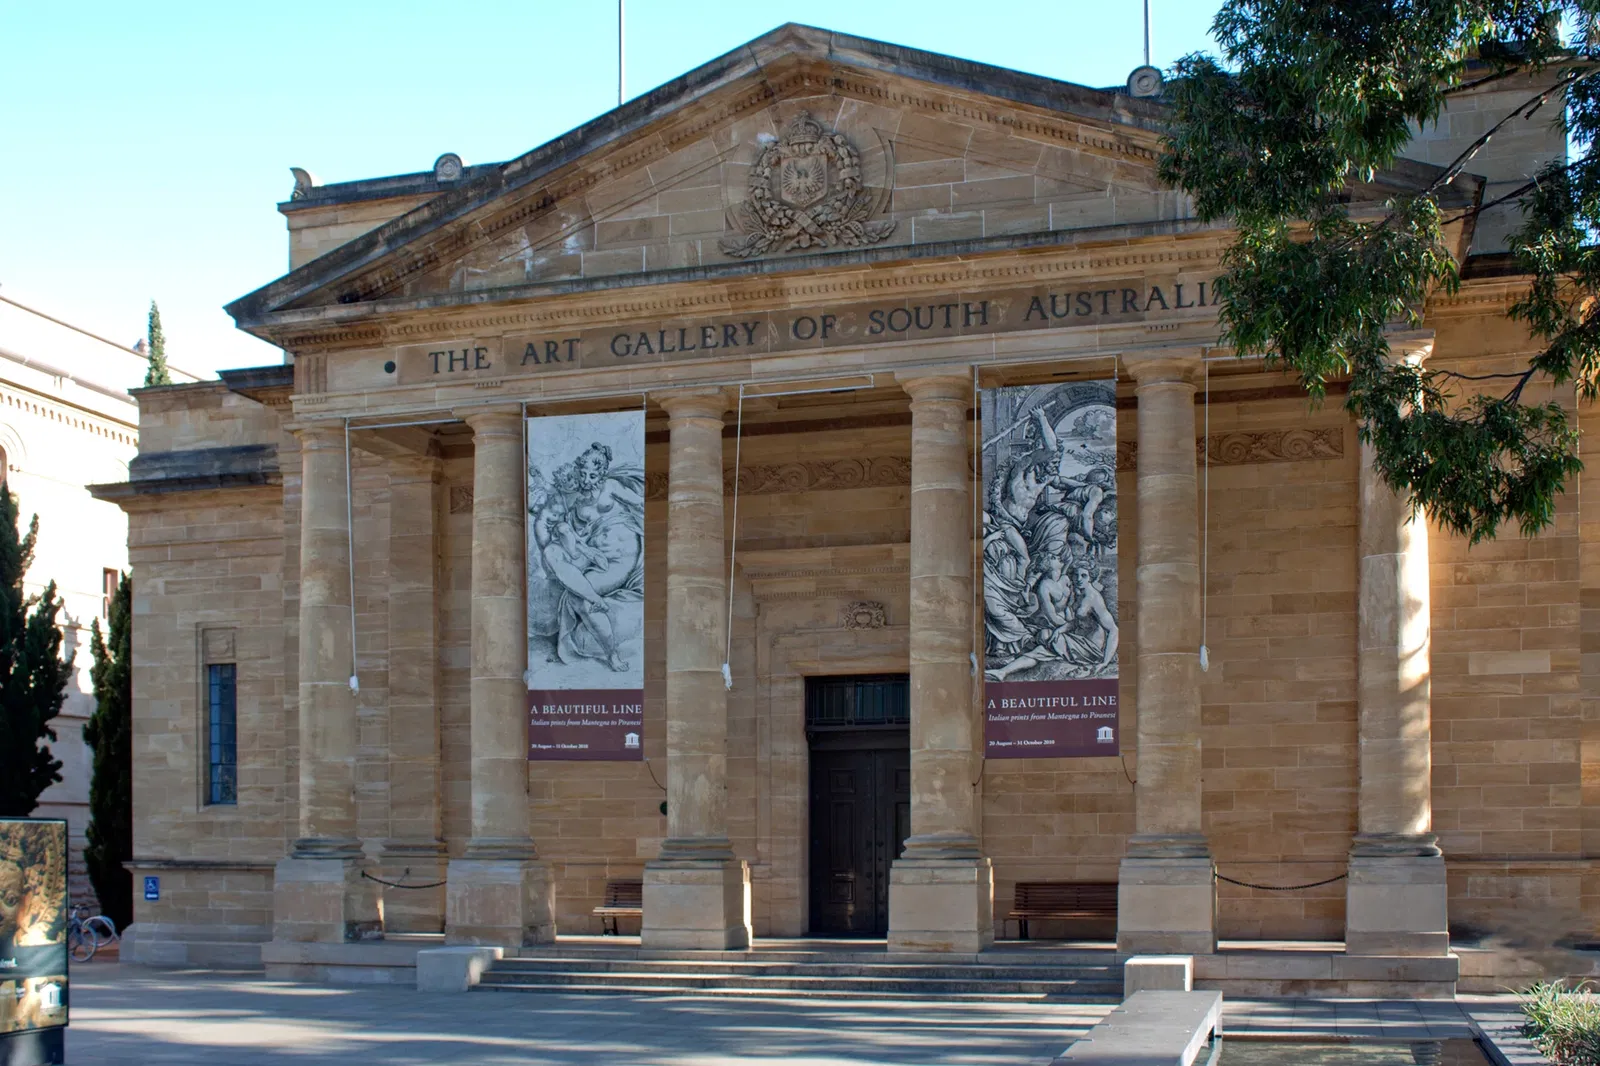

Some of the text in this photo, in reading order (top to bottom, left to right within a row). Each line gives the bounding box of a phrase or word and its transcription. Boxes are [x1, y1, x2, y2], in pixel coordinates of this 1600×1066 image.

[428, 346, 491, 374] THE
[520, 338, 580, 366] ART
[610, 321, 760, 357] GALLERY
[792, 314, 837, 340] OF
[868, 300, 989, 334] SOUTH
[988, 695, 1117, 709] A BEAUTIFUL LINE
[530, 704, 642, 714] A BEAUTIFUL LINE
[1010, 714, 1029, 722] prints
[1030, 713, 1046, 722] from
[1047, 712, 1080, 721] Mantegna
[1089, 711, 1116, 719] Piranesi
[531, 718, 550, 726] Italian
[550, 718, 566, 727] prints
[566, 718, 581, 727] from
[611, 718, 617, 726] to
